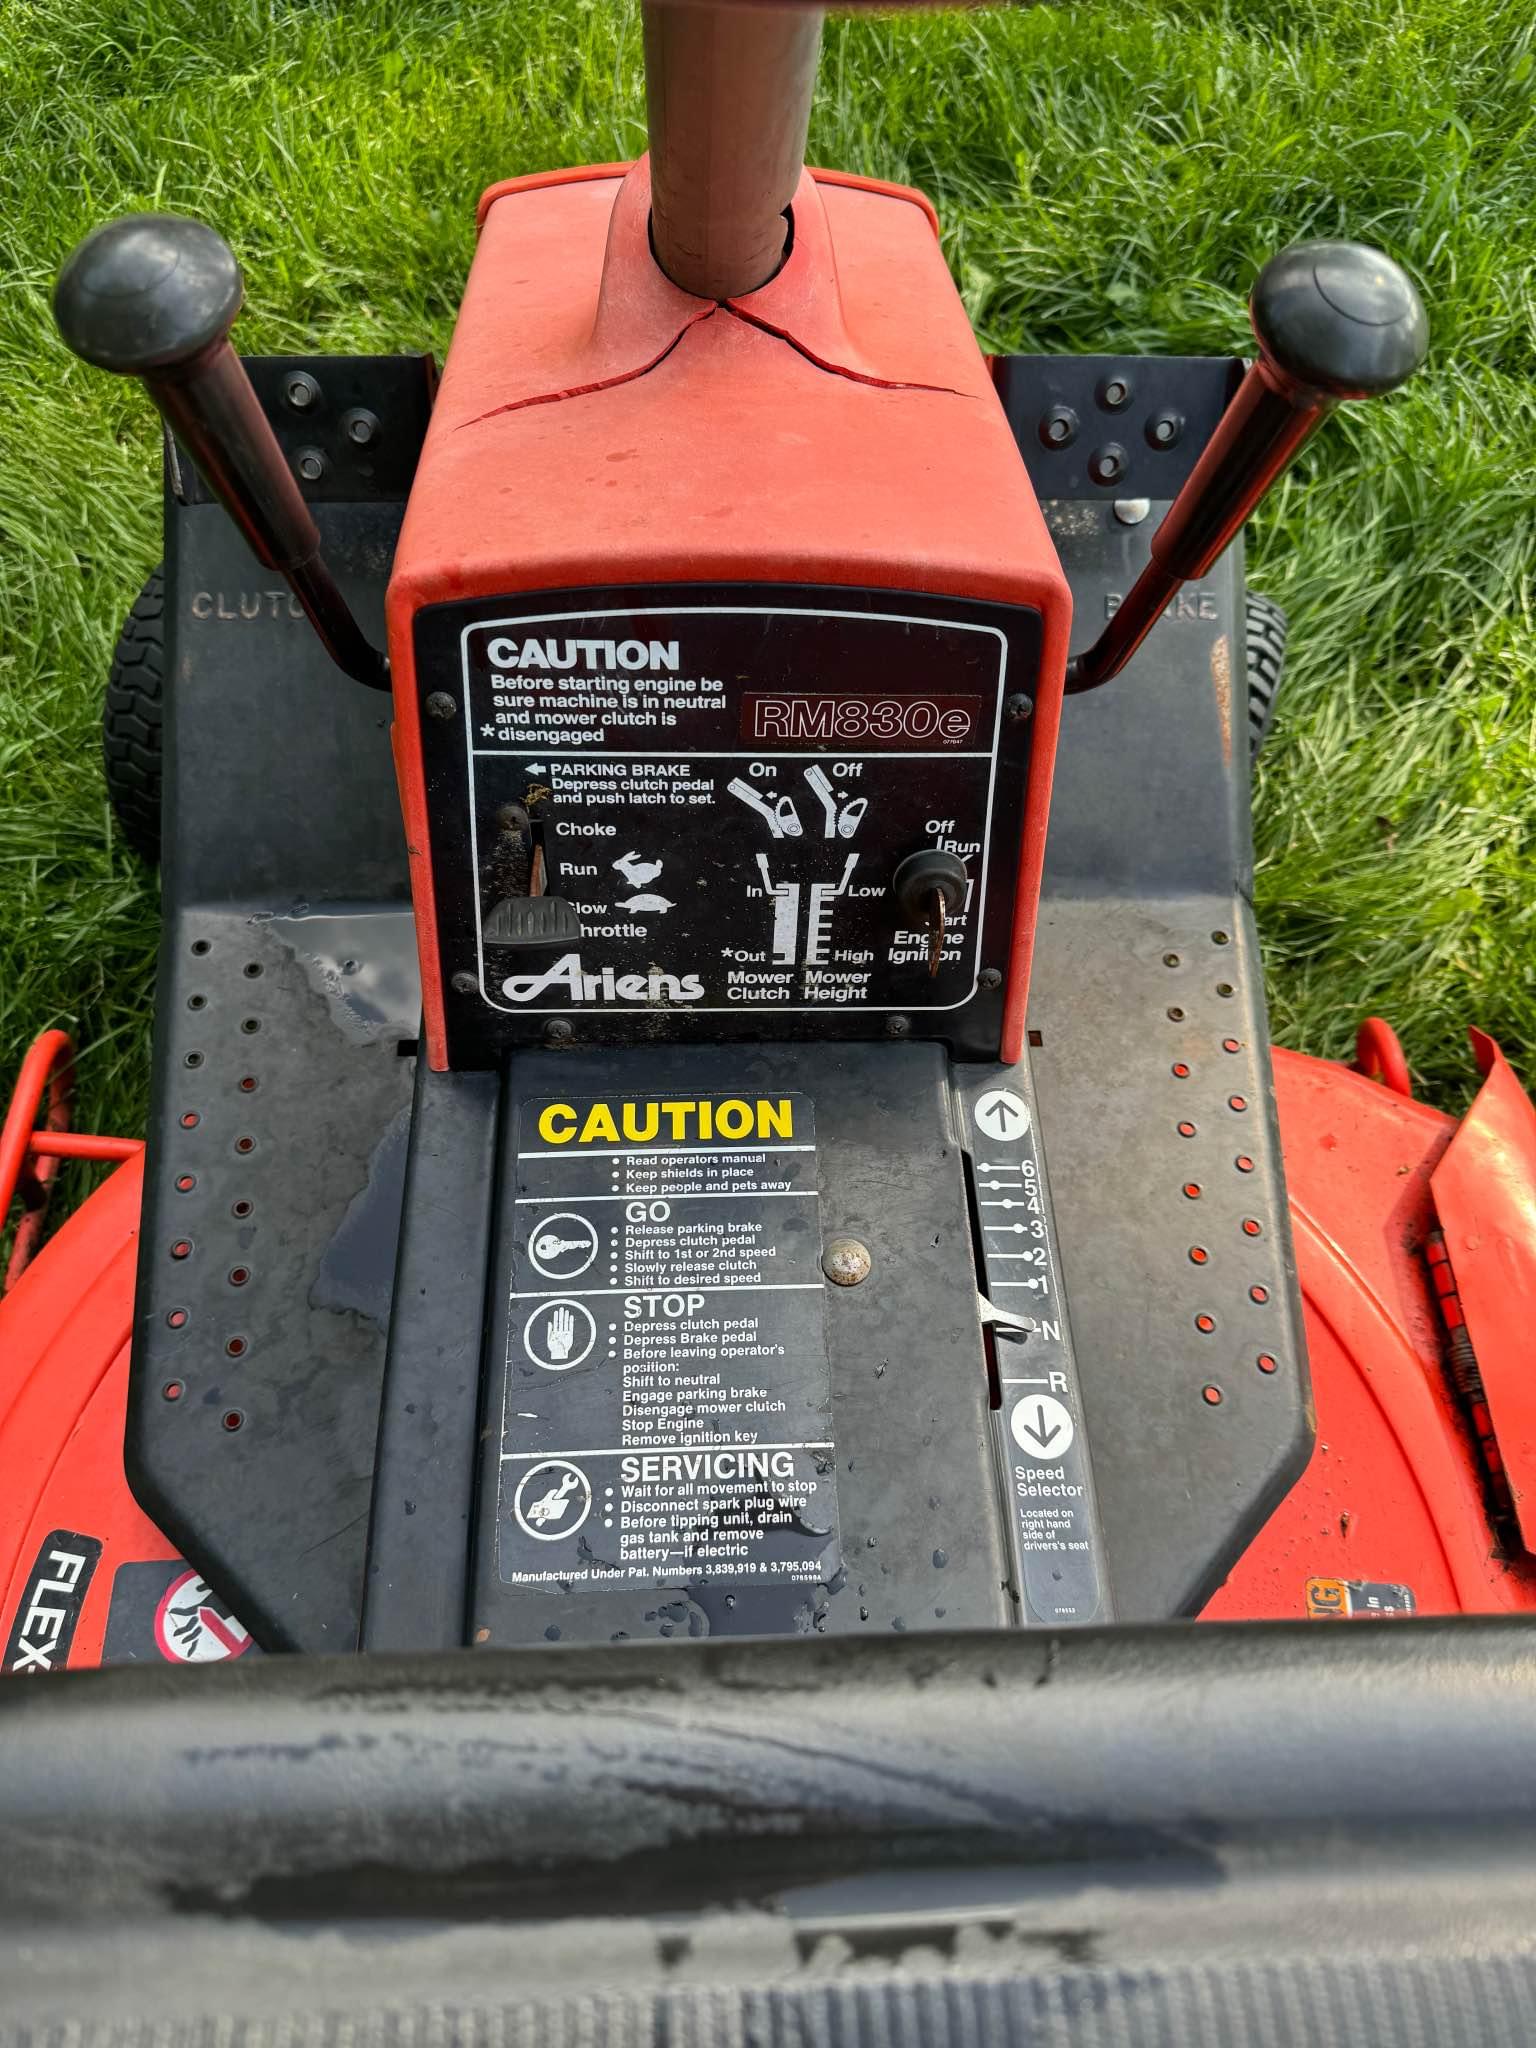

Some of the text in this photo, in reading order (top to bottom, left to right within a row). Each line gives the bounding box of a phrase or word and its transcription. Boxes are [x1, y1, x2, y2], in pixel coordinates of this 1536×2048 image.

[192, 592, 305, 619] CLUTC
[487, 638, 679, 670] CAUTION
[491, 675, 724, 694] Before starting engine be
[493, 695, 725, 709] sure machine is in neutral
[496, 712, 676, 725] and mower clutch is
[755, 700, 971, 739] RM830e
[551, 765, 690, 777] PARKING BRAKE
[749, 762, 777, 777] On
[833, 762, 862, 777] Off
[552, 779, 714, 792] Depress clutch pedal
[553, 793, 715, 805] and push latch to set.
[556, 822, 616, 836] Choke
[925, 820, 955, 834] Off
[944, 840, 980, 852] Run
[560, 863, 597, 875] Run
[747, 886, 762, 897] In
[849, 885, 886, 897] Low
[581, 924, 647, 937] hrottle
[835, 950, 873, 963] High
[502, 954, 705, 1001] Ariens
[728, 971, 871, 984] Mower Mower
[727, 987, 867, 1000] Clutch Height
[538, 1100, 792, 1144] CAUTION
[626, 1154, 766, 1168] Read operators manual
[626, 1168, 754, 1180] Keep shields in place
[1022, 1160, 1034, 1177] 6
[626, 1180, 792, 1194] Keep people and pets away
[1024, 1179, 1037, 1196] 5
[626, 1201, 670, 1222] GO
[1028, 1197, 1040, 1214] 4
[626, 1222, 762, 1236] Release parking brake
[1030, 1220, 1044, 1238] 3
[625, 1236, 755, 1250] Depress clutch pedal
[625, 1247, 776, 1260] Shift to 1st or 2nd speed
[1032, 1248, 1047, 1266] 2
[624, 1260, 756, 1275] Slowly release clutch
[624, 1273, 760, 1286] Shift to desired speed
[1038, 1275, 1048, 1294] 1
[624, 1295, 705, 1319] STOP
[624, 1318, 758, 1333] Depress clutch pedal
[1042, 1320, 1061, 1341] N
[624, 1332, 756, 1347] Depress Brake pedal
[624, 1344, 784, 1360] Before leaving operator's
[623, 1362, 679, 1375] position:
[623, 1375, 720, 1387] Shift to neutral
[1049, 1372, 1068, 1393] R
[623, 1388, 767, 1404] Engage parking brake
[623, 1401, 785, 1417] Disengage mower clutch
[622, 1418, 704, 1432] Stop Engine
[623, 1431, 758, 1445] Remove ignition key
[621, 1452, 794, 1483] SERVICING
[1015, 1466, 1064, 1482] Speed
[622, 1480, 817, 1498] Wait for all movement to stop
[1017, 1483, 1083, 1497] Selector
[622, 1497, 806, 1513] Disconnect spark plug wire
[1020, 1509, 1058, 1517] Located
[621, 1512, 792, 1529] Before tipping unit, drain
[1022, 1519, 1071, 1530] right hand
[620, 1528, 763, 1546] gas tank and remove
[1022, 1530, 1055, 1539] side of
[698, 1544, 748, 1556] electric
[1069, 1541, 1088, 1550] seat
[512, 1561, 821, 1582] Manufactured Under Pat. Numbers 3,839,919 & 3,795,094
